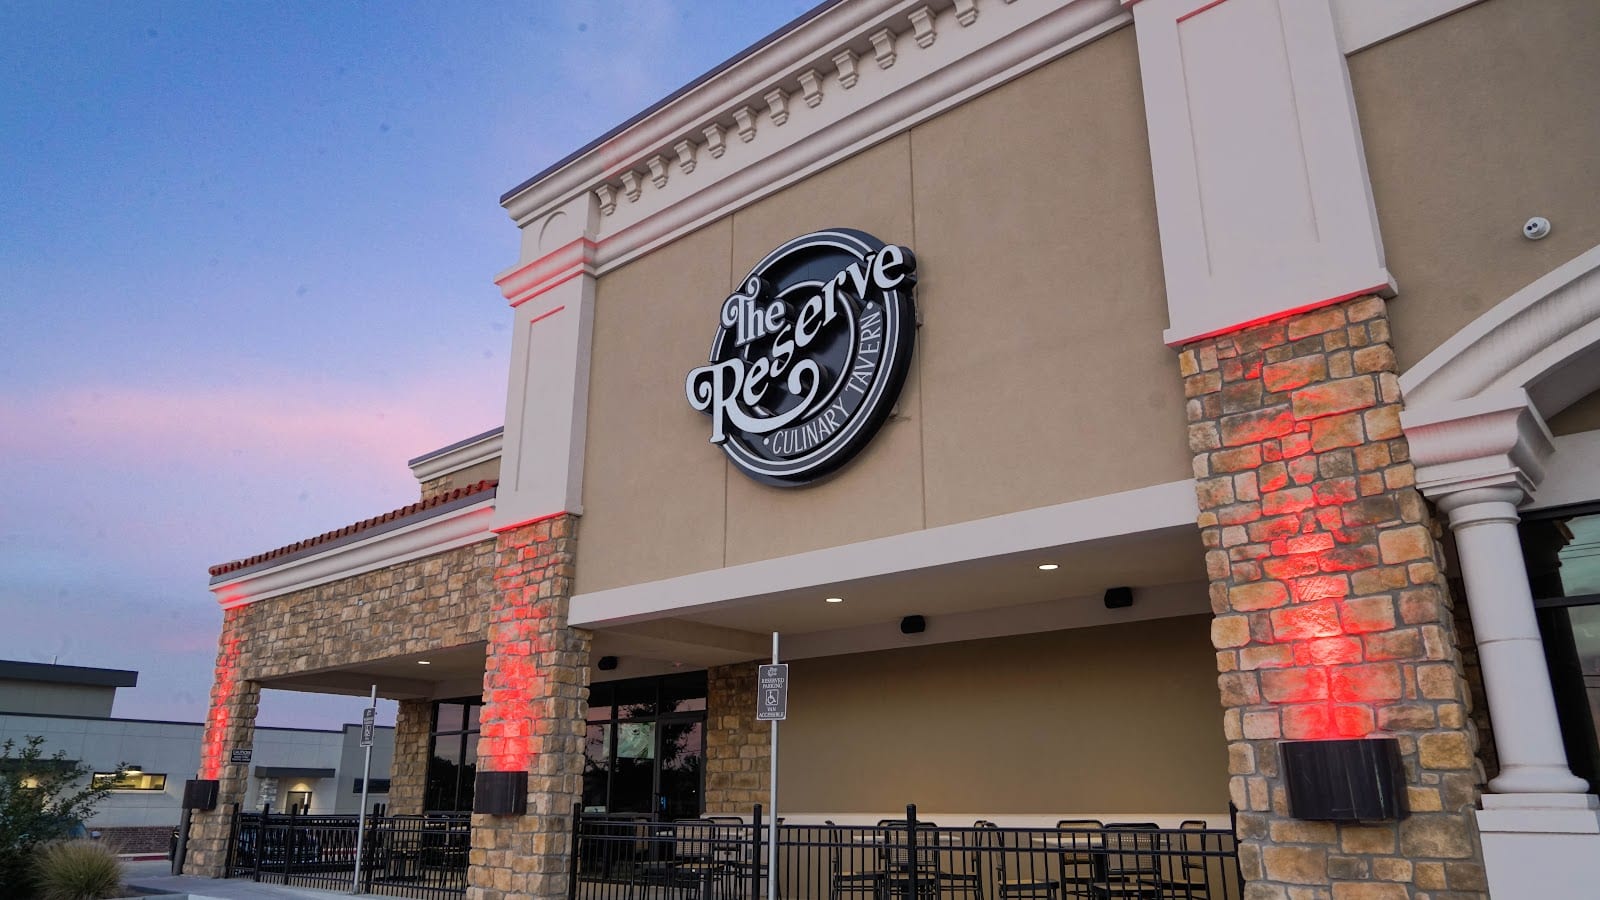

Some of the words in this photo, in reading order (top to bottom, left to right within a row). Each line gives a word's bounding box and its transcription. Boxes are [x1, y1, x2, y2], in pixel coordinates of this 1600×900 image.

[686, 244, 905, 443] Reserve
[722, 276, 785, 347] The
[772, 398, 850, 454] CULINARY
[845, 310, 881, 396] TAVERN
